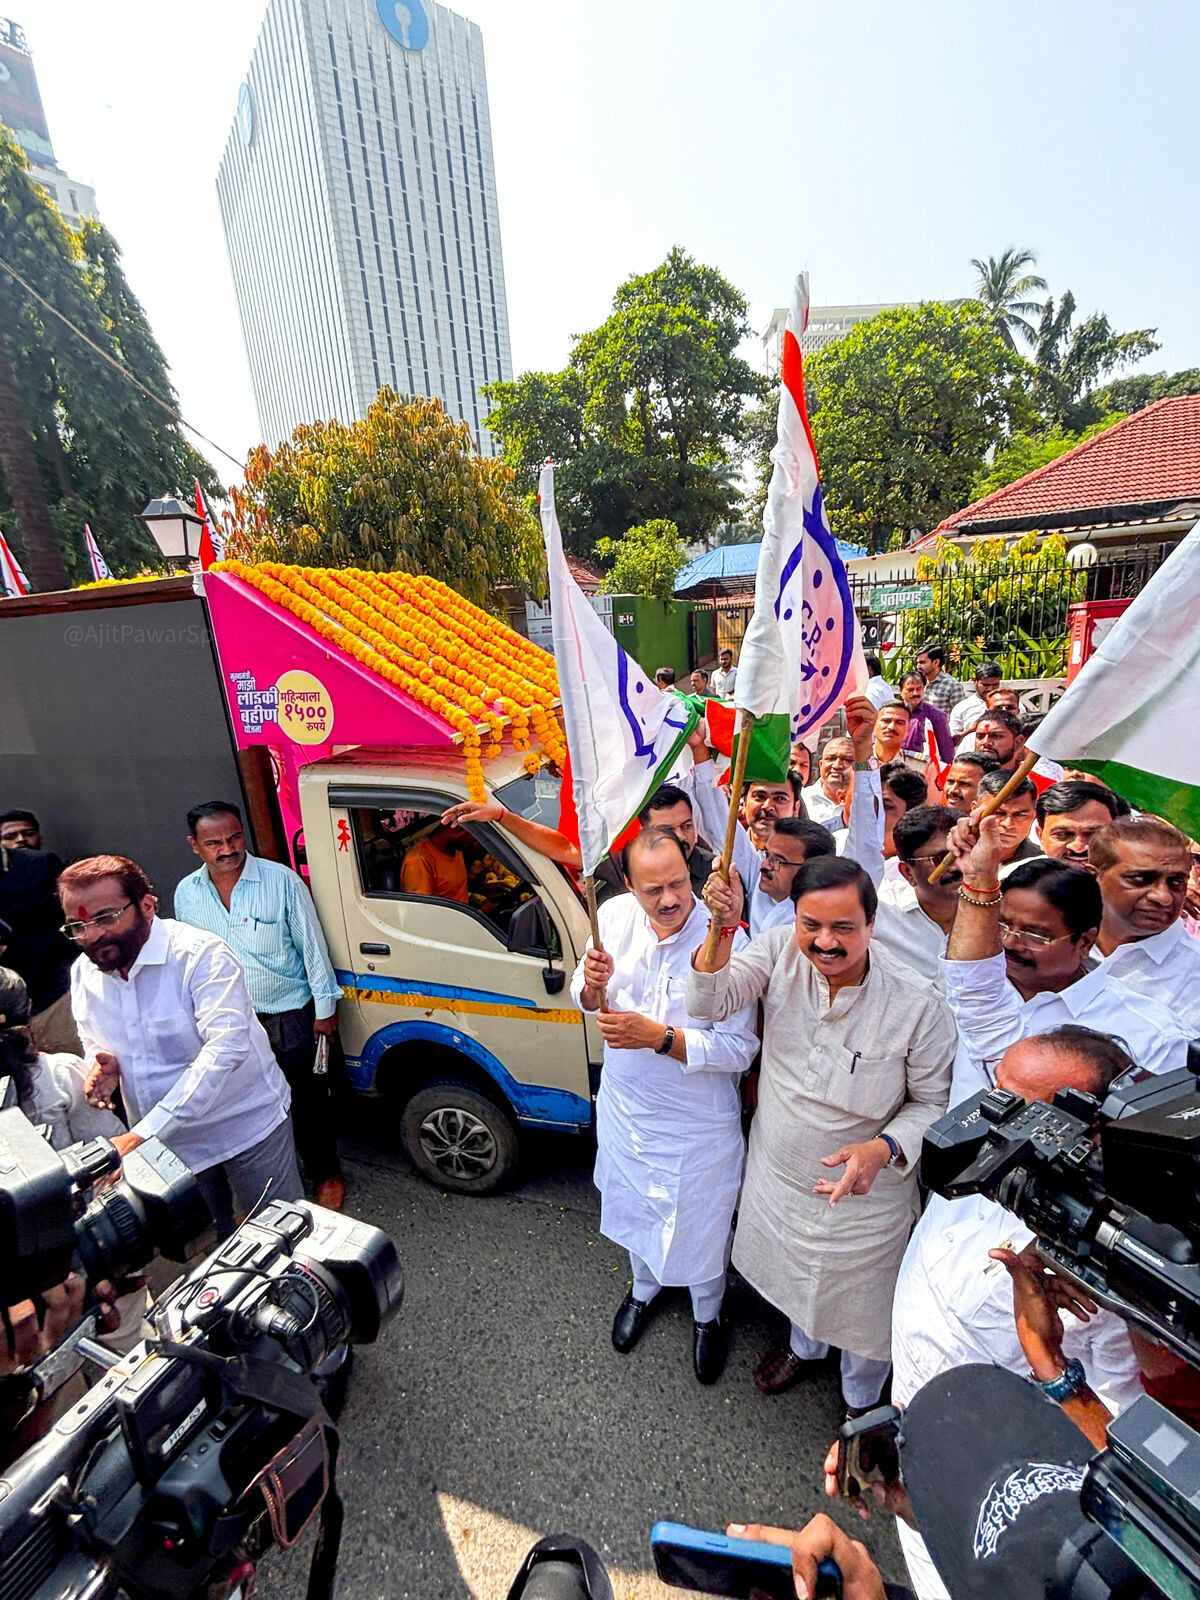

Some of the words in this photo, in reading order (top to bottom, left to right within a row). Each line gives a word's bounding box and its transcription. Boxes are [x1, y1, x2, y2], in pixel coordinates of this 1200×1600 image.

[236, 677, 256, 690] माझी
[236, 686, 279, 706] लाडकी
[280, 690, 321, 703] महिन्याला
[240, 704, 279, 724] बहीण
[284, 703, 327, 722] १५००
[243, 724, 262, 734] योजना
[306, 719, 326, 732] रुपये
